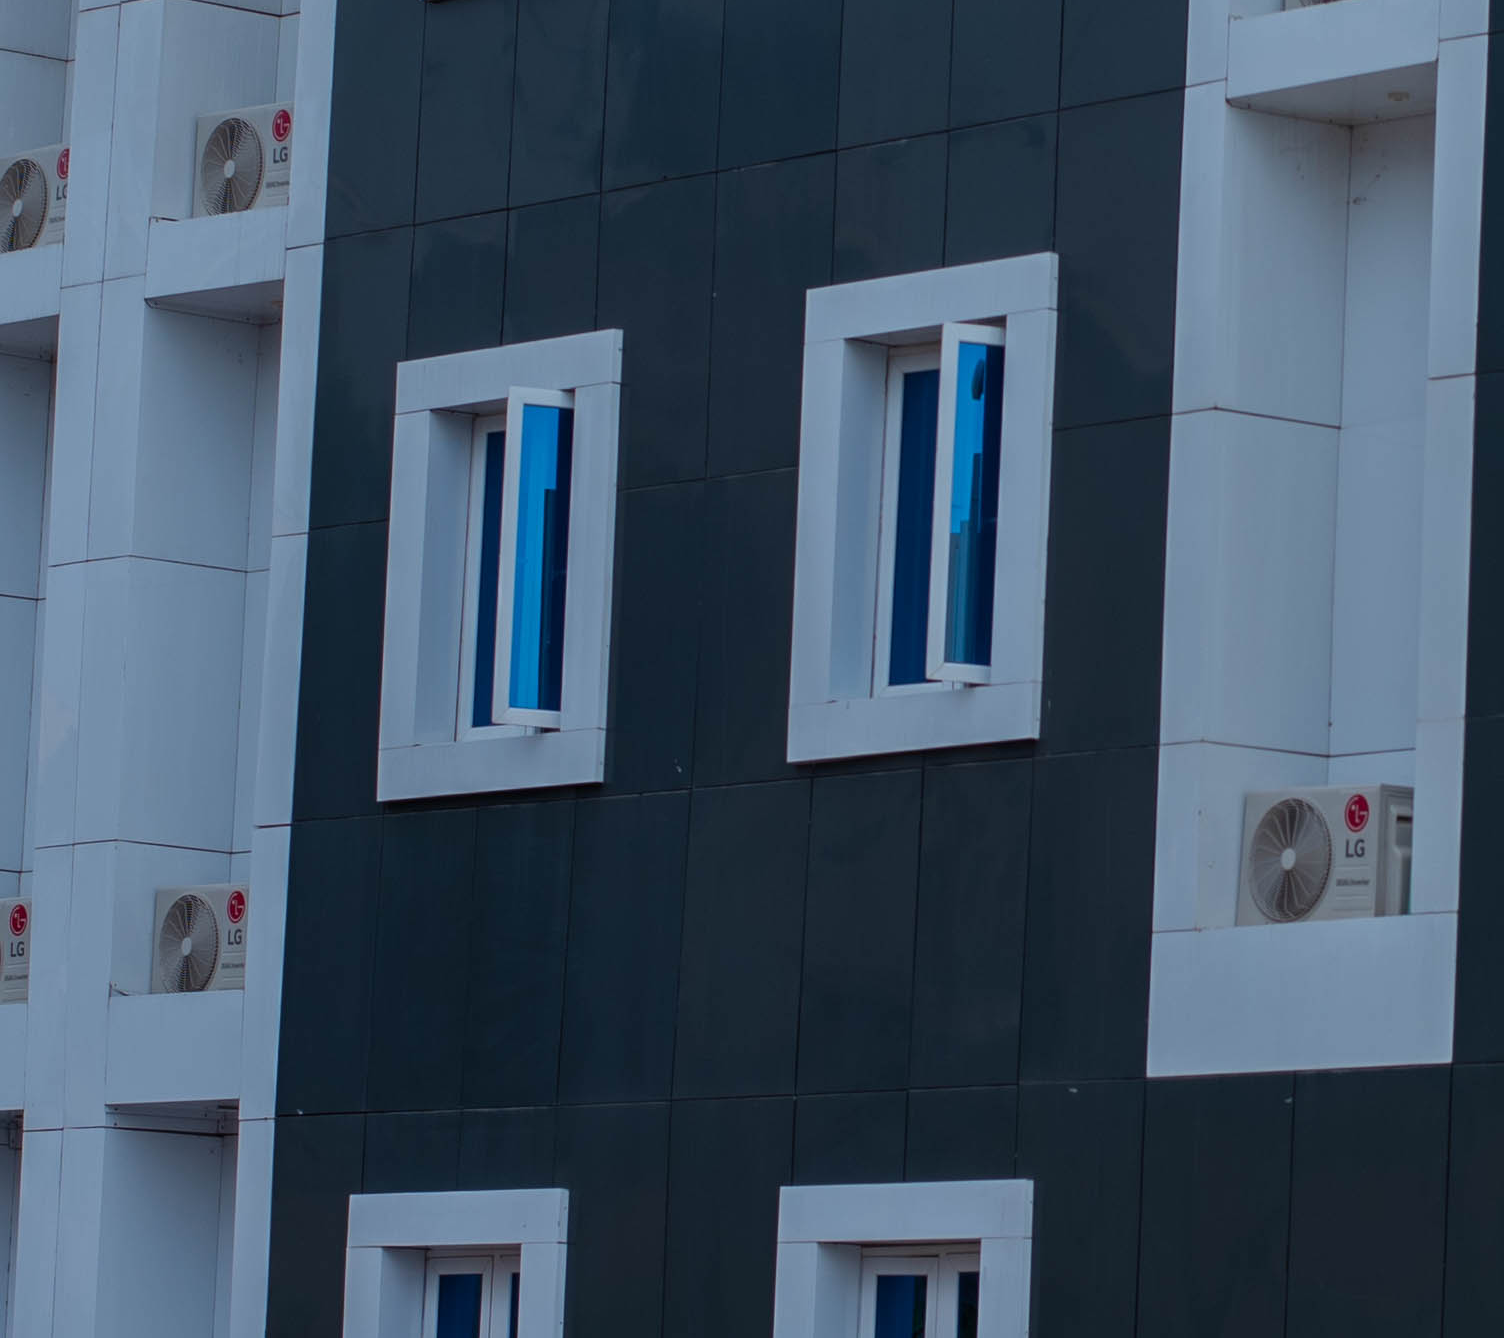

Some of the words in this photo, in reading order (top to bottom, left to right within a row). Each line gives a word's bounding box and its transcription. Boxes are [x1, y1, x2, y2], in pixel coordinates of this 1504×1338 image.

[272, 146, 289, 164] LG
[1345, 839, 1365, 858] LG
[226, 929, 243, 946] LG
[9, 941, 25, 958] LG
